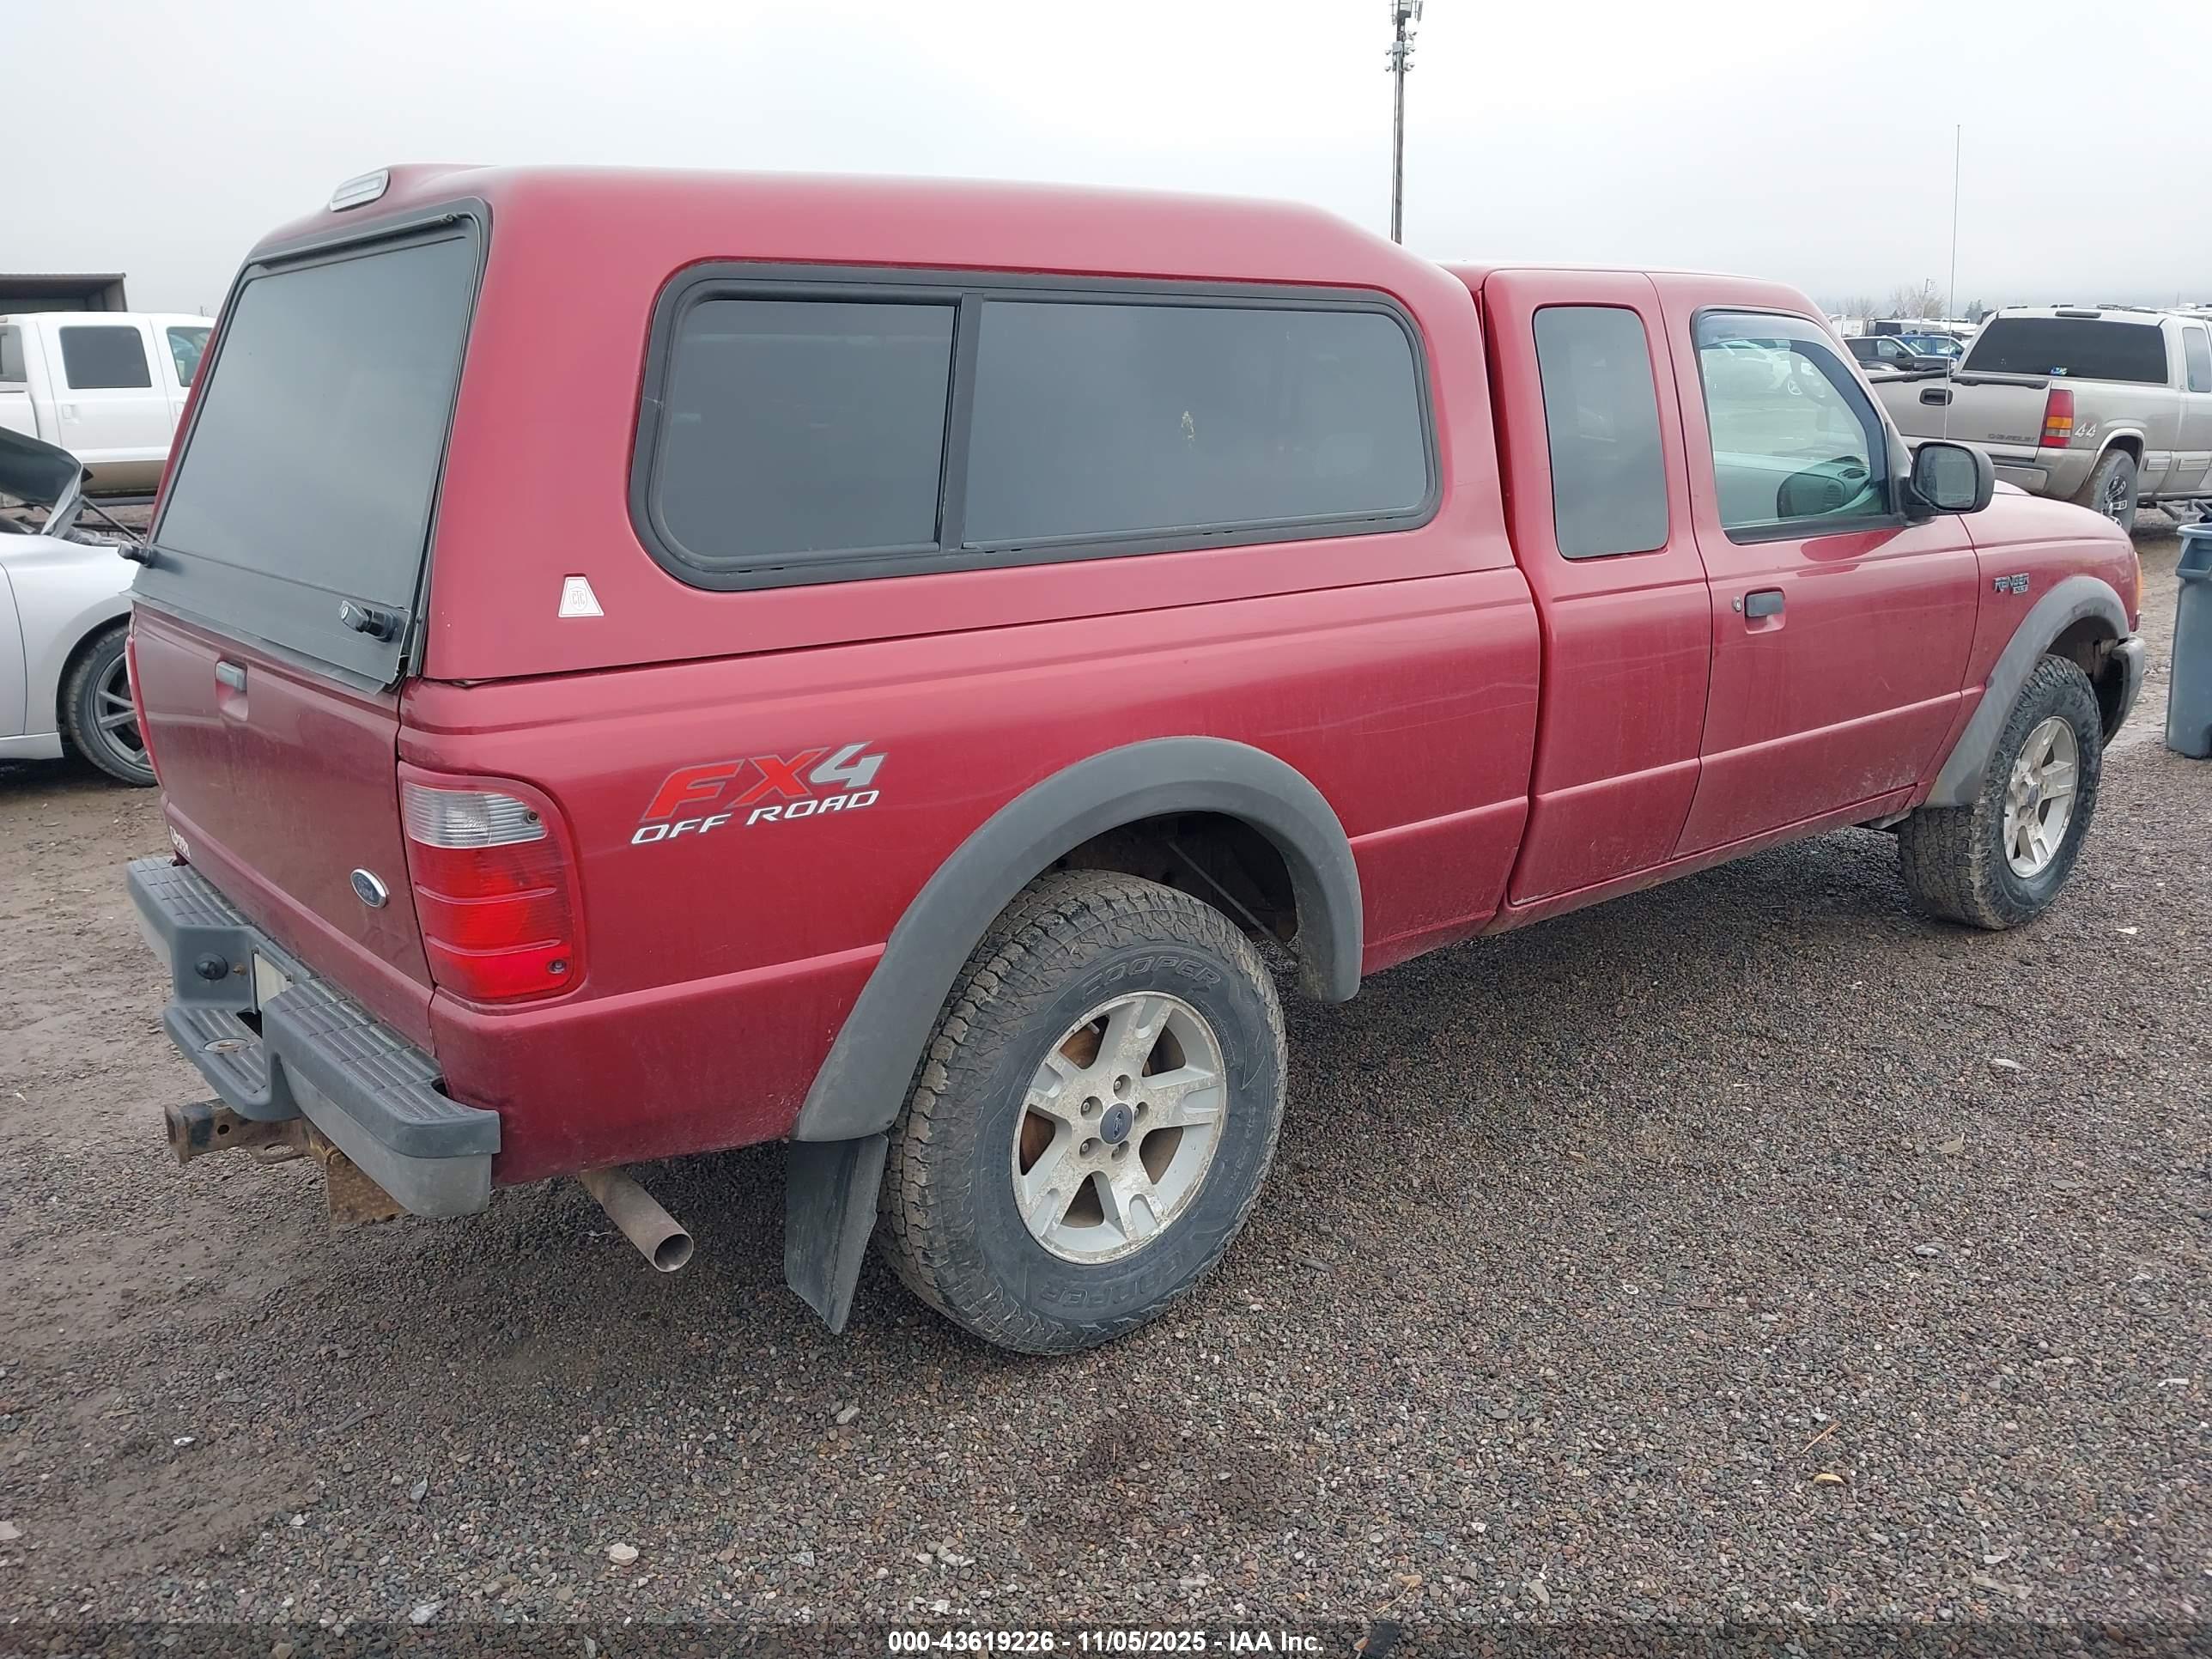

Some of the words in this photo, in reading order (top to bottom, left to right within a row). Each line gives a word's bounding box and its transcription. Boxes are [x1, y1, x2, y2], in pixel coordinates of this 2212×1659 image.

[639, 740, 888, 823] FX4
[631, 813, 731, 844] OFF
[746, 790, 880, 825] ROAD
[1082, 956, 1220, 1000] COOPER
